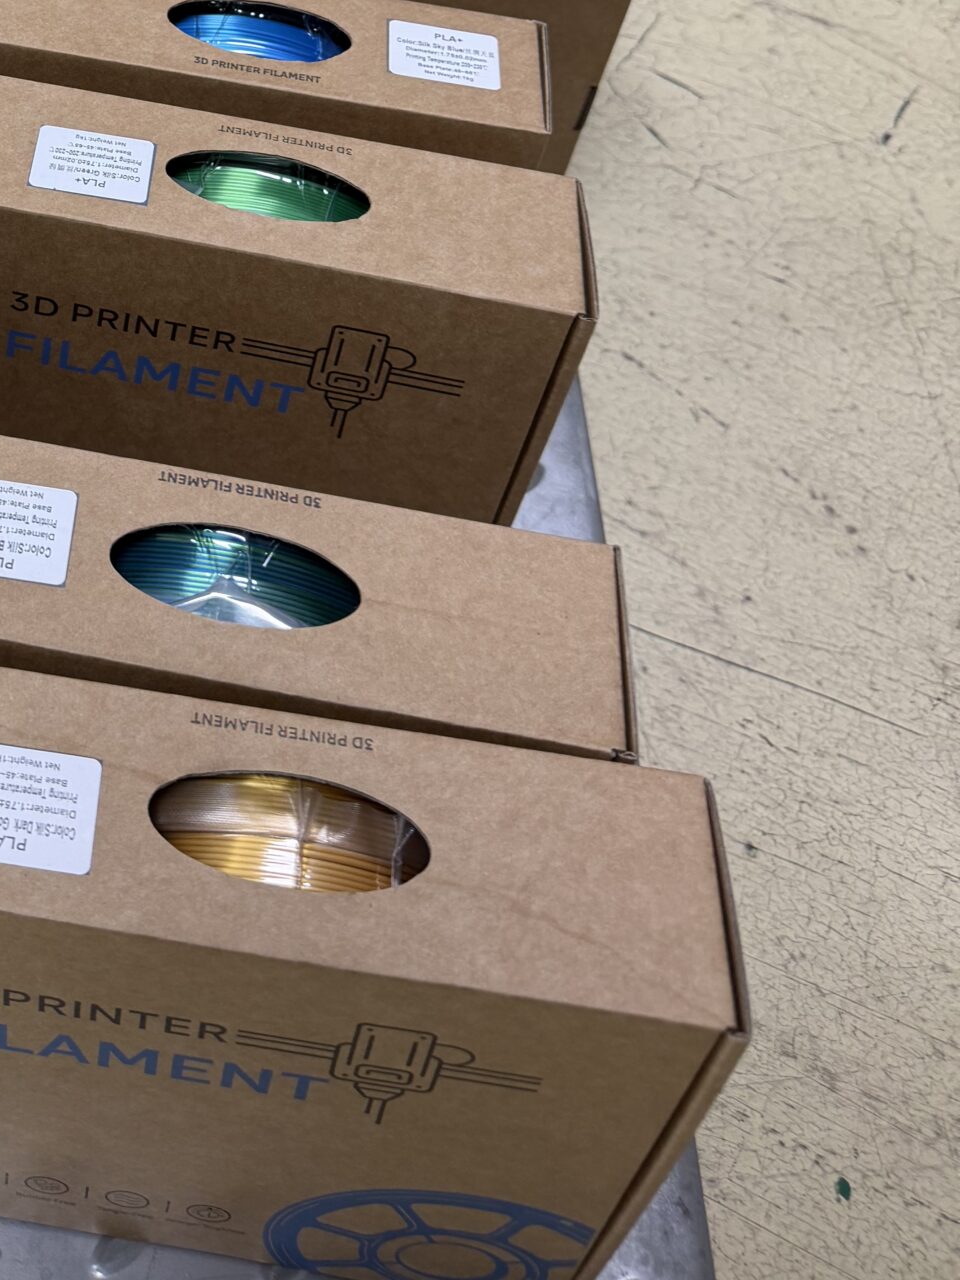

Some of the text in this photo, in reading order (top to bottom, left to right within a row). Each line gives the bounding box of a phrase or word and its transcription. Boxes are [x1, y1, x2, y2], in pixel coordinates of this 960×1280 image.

[434, 32, 464, 43] PLA+
[432, 42, 445, 51] Sky
[193, 55, 322, 84] 3D PRINTER FILAMENT
[217, 124, 353, 156] 3D PRINTER FILAMENT
[74, 177, 106, 188] PLA+
[102, 170, 141, 183] Color:Silk
[9, 290, 236, 353] 3D PRINTER
[6, 330, 306, 413] FILAMENT
[29, 490, 44, 500] Net
[157, 470, 322, 509] 3D PRINTER FILAMENT
[31, 503, 53, 513] Base
[31, 514, 58, 529] Printing
[6, 540, 52, 559] Color:Silk
[190, 711, 374, 752] 3D PRINTER FILAMENT
[44, 761, 61, 771] Net
[44, 776, 68, 788] Base
[48, 787, 79, 805] Printing
[13, 818, 34, 835] Dark
[35, 821, 77, 841] Color:Silk
[2, 988, 228, 1044] PRINTER
